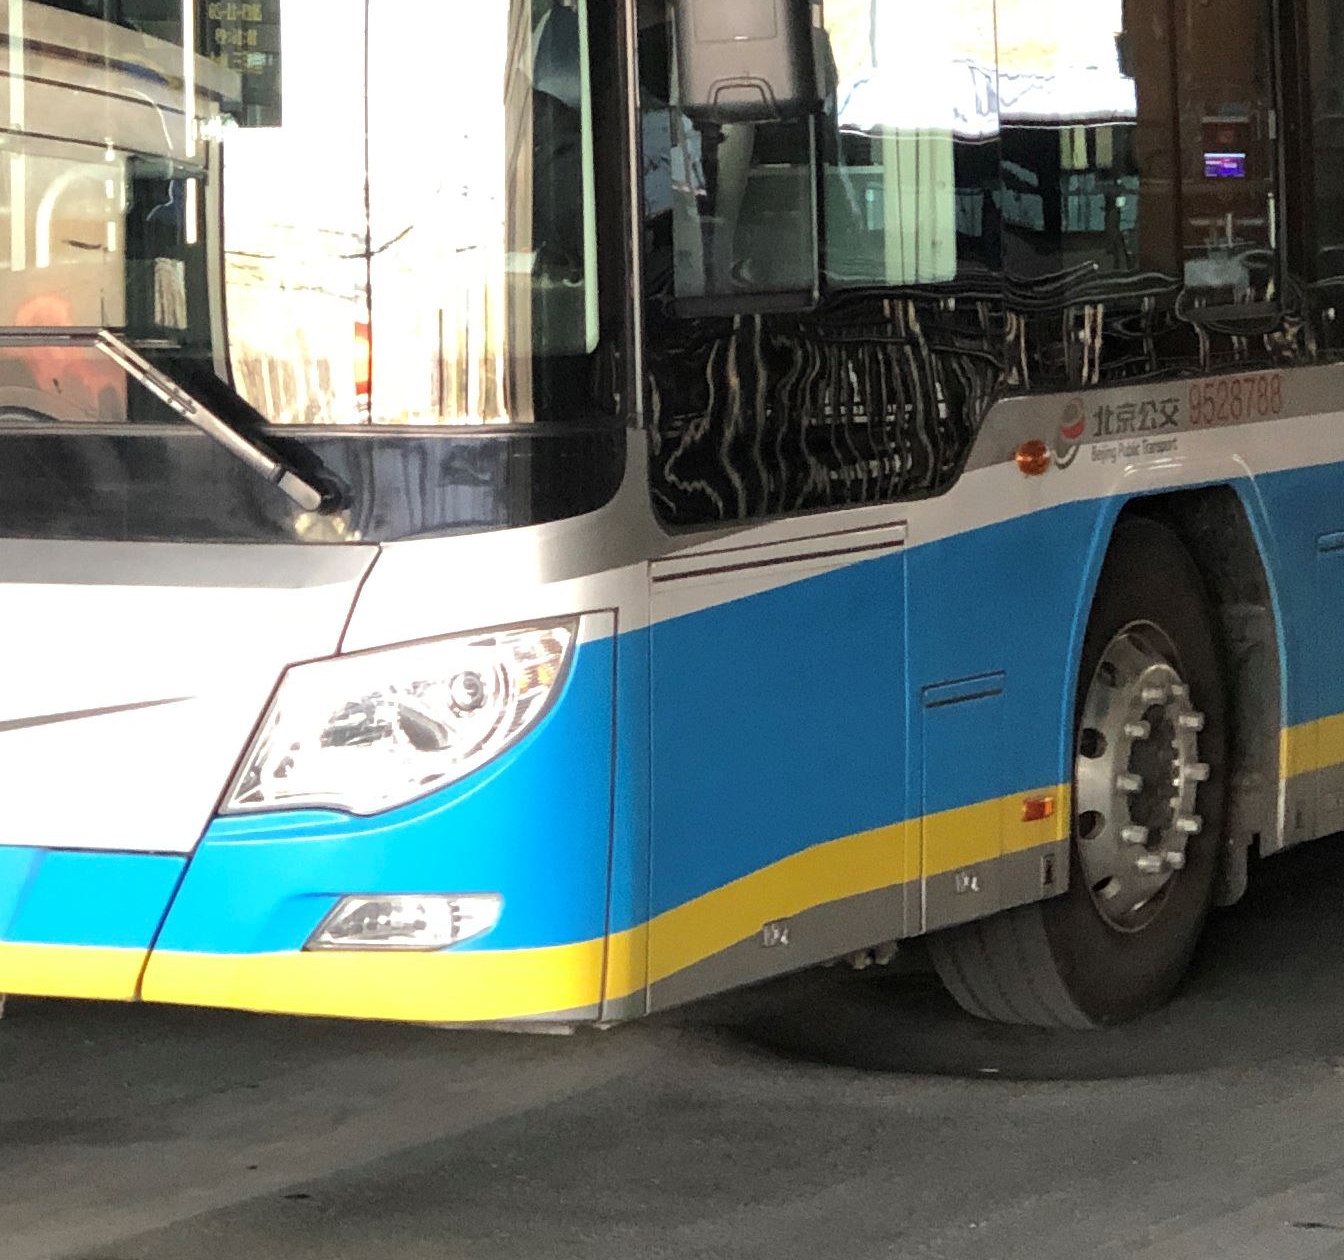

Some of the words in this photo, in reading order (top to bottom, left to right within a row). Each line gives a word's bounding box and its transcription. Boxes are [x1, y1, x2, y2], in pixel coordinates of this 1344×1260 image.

[1092, 397, 1181, 437] 北京公交
[1188, 373, 1282, 425] 9528788
